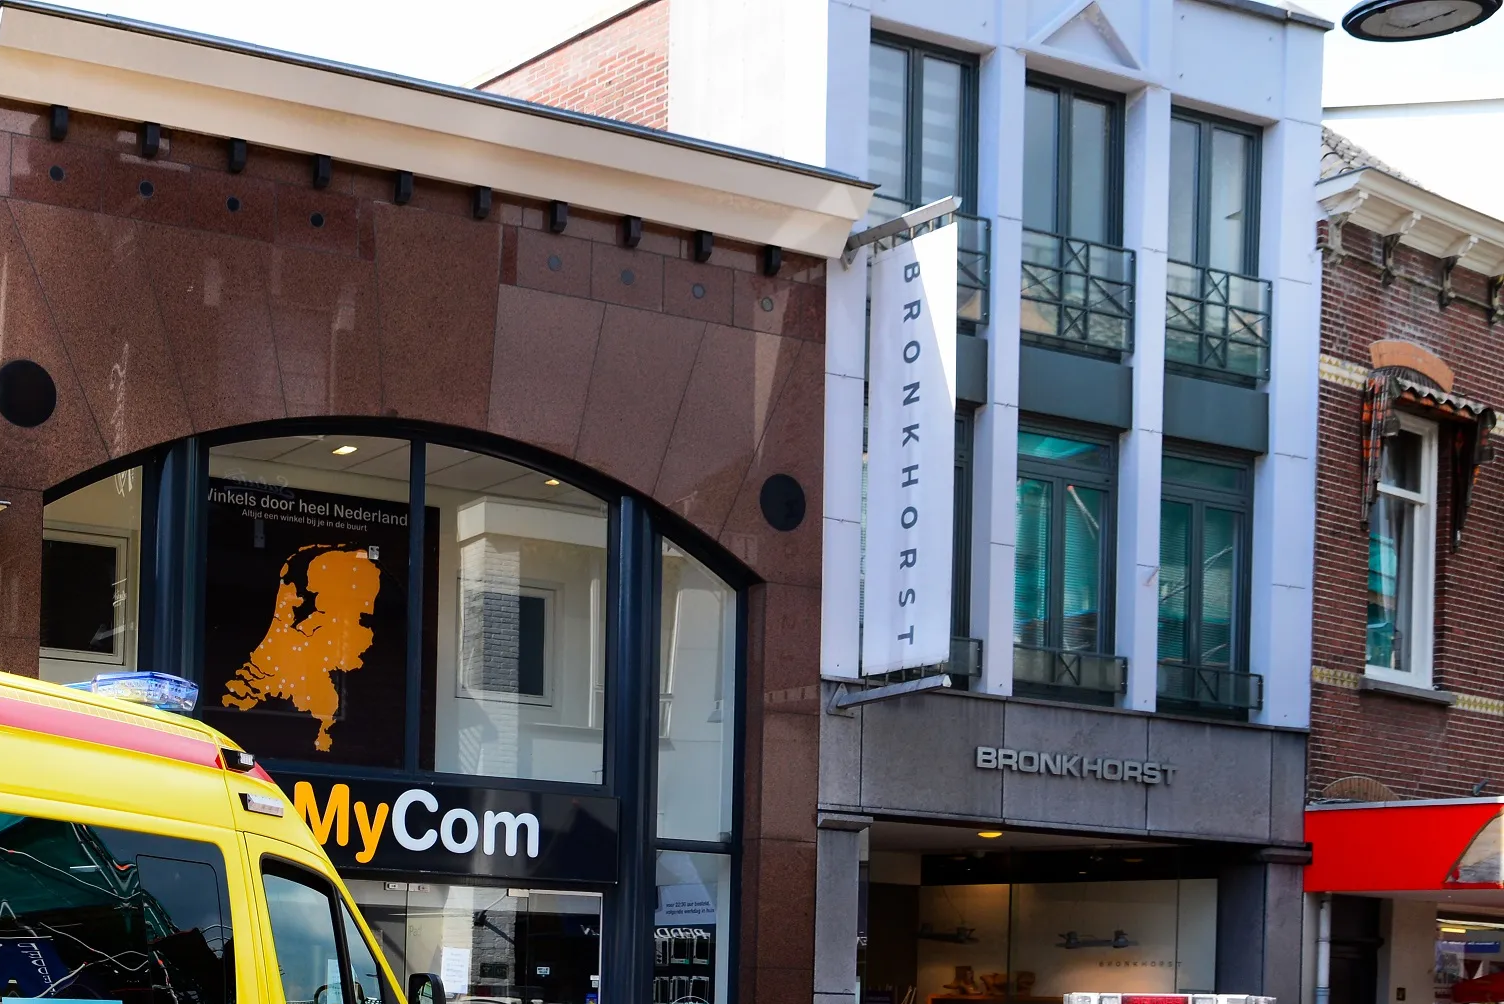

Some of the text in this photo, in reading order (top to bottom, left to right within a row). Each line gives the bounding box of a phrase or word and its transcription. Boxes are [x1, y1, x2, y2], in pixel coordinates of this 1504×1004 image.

[897, 261, 921, 645] BRONKHORST
[242, 508, 262, 519] Altijd
[280, 514, 305, 524] winkel
[306, 517, 316, 527] bij
[316, 519, 325, 527] je
[326, 519, 333, 527] in
[335, 520, 345, 529] de
[346, 521, 367, 532] buurt
[261, 495, 295, 511] door
[299, 499, 330, 515] heel
[334, 504, 408, 526] Nederland
[976, 746, 1179, 785] BRONKHORST
[294, 781, 539, 863] MyCom
